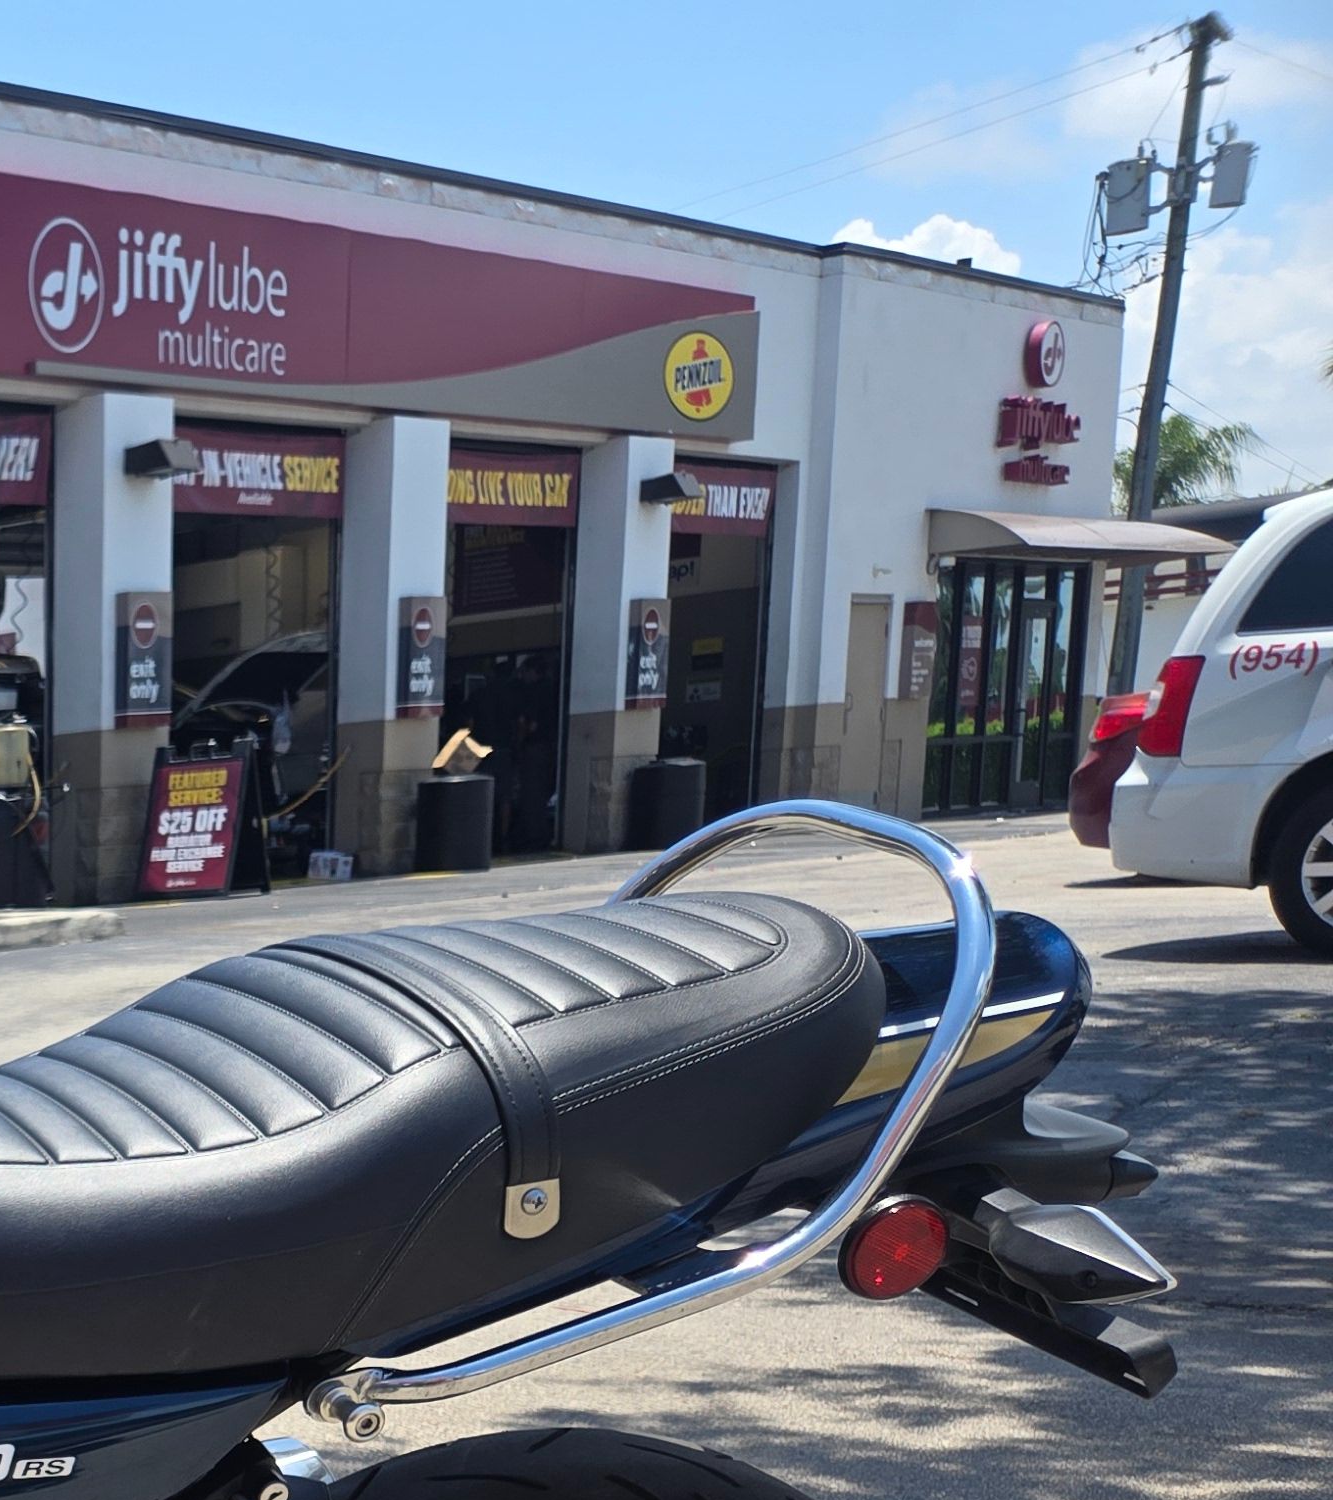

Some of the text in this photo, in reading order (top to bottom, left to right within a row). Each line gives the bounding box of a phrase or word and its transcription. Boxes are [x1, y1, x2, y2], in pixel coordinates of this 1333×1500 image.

[112, 227, 288, 325] jiffy lube
[158, 321, 287, 376] multicare
[674, 359, 725, 393] PENNZOIL
[284, 455, 340, 493] SERVICE
[448, 469, 475, 504] ONG
[476, 471, 505, 505] LIVE
[507, 472, 542, 507] YOUR
[707, 485, 738, 518] THAN
[1229, 640, 1319, 680] (954)
[157, 806, 228, 835] $25 OFF
